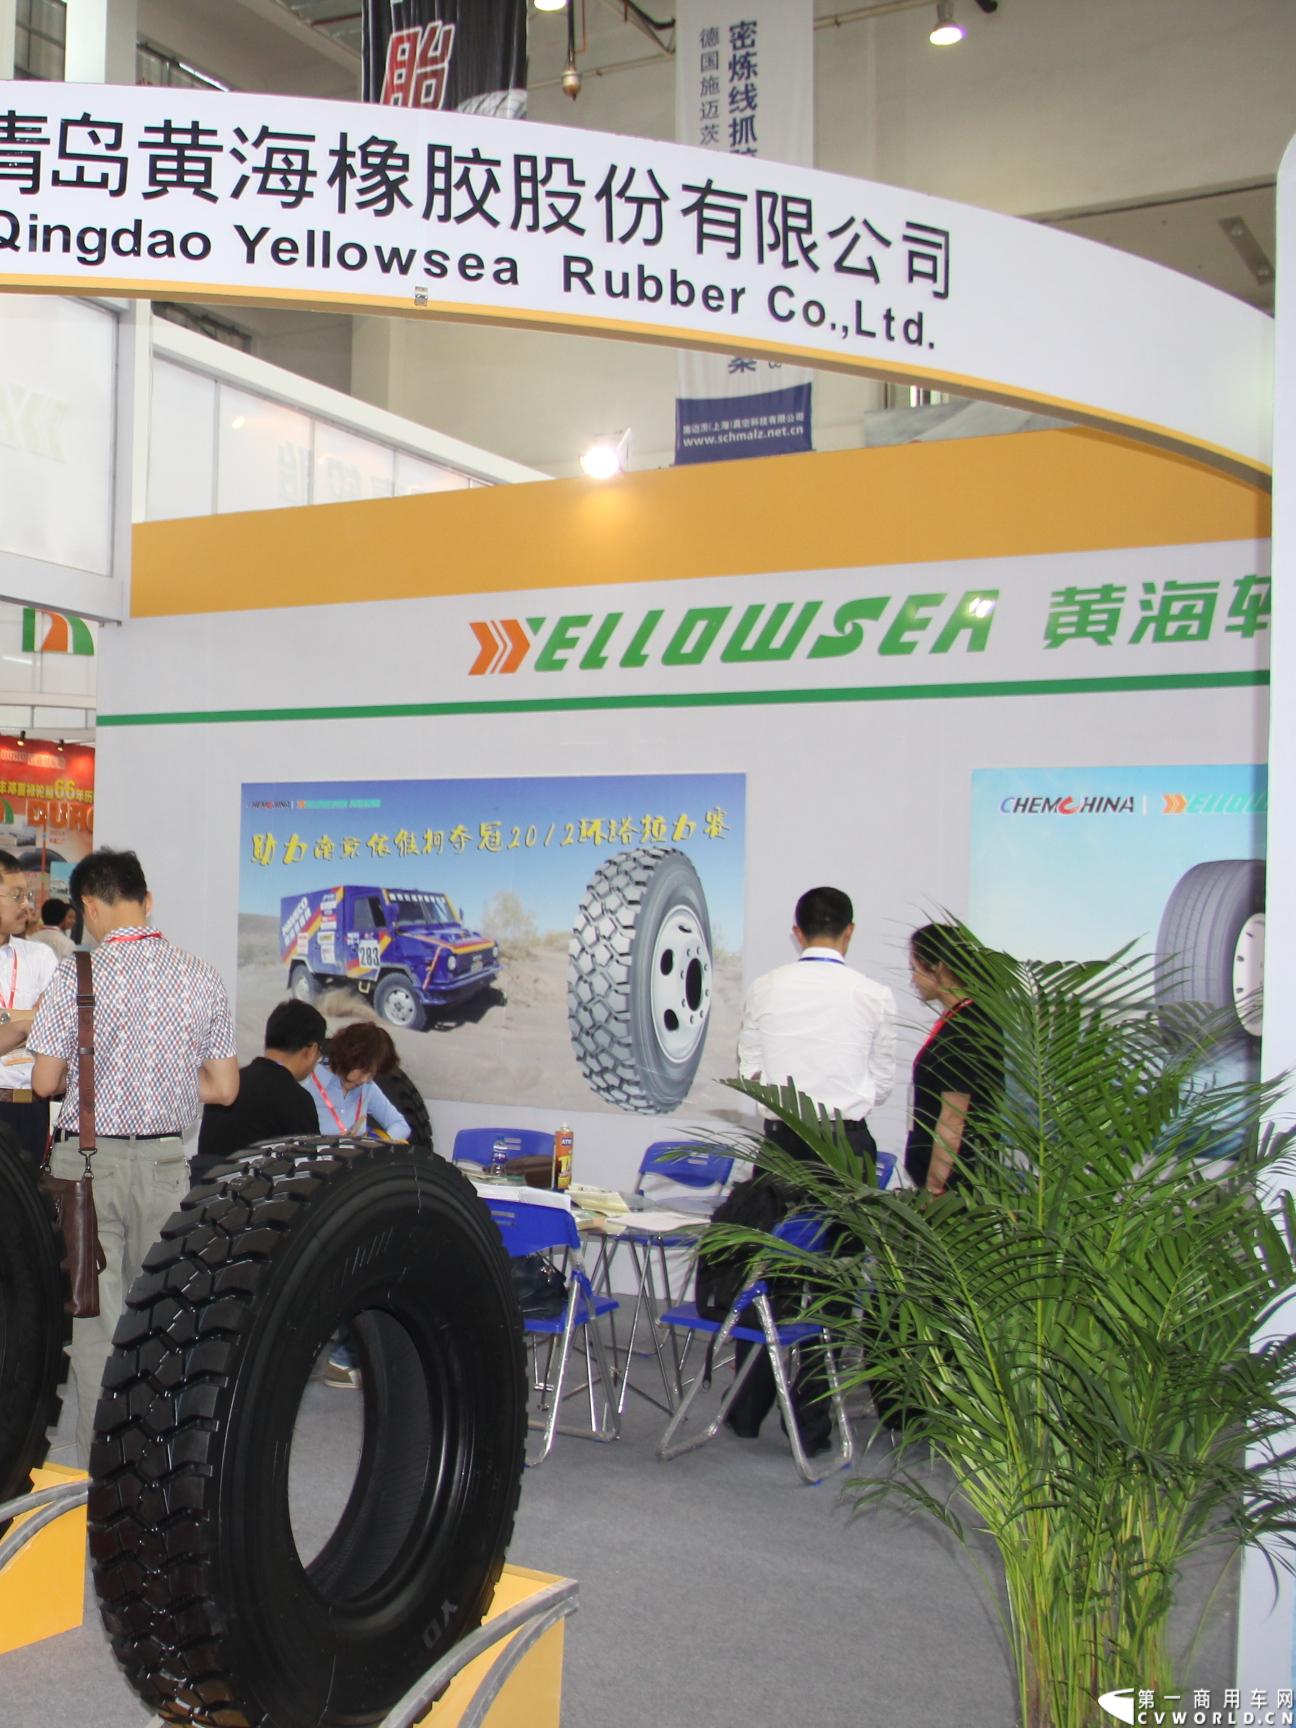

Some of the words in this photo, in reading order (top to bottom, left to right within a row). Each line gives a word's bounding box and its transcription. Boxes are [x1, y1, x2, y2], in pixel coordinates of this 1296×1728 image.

[234, 224, 520, 286] Yellowsea
[563, 254, 747, 316] Rubber
[768, 285, 936, 350] Co.,Ltd.
[682, 425, 804, 447] www.schmalz.net.cn
[525, 589, 1000, 672] YELLOWSEA
[1000, 795, 1135, 815] CHEMCHINA
[360, 946, 380, 967] 283
